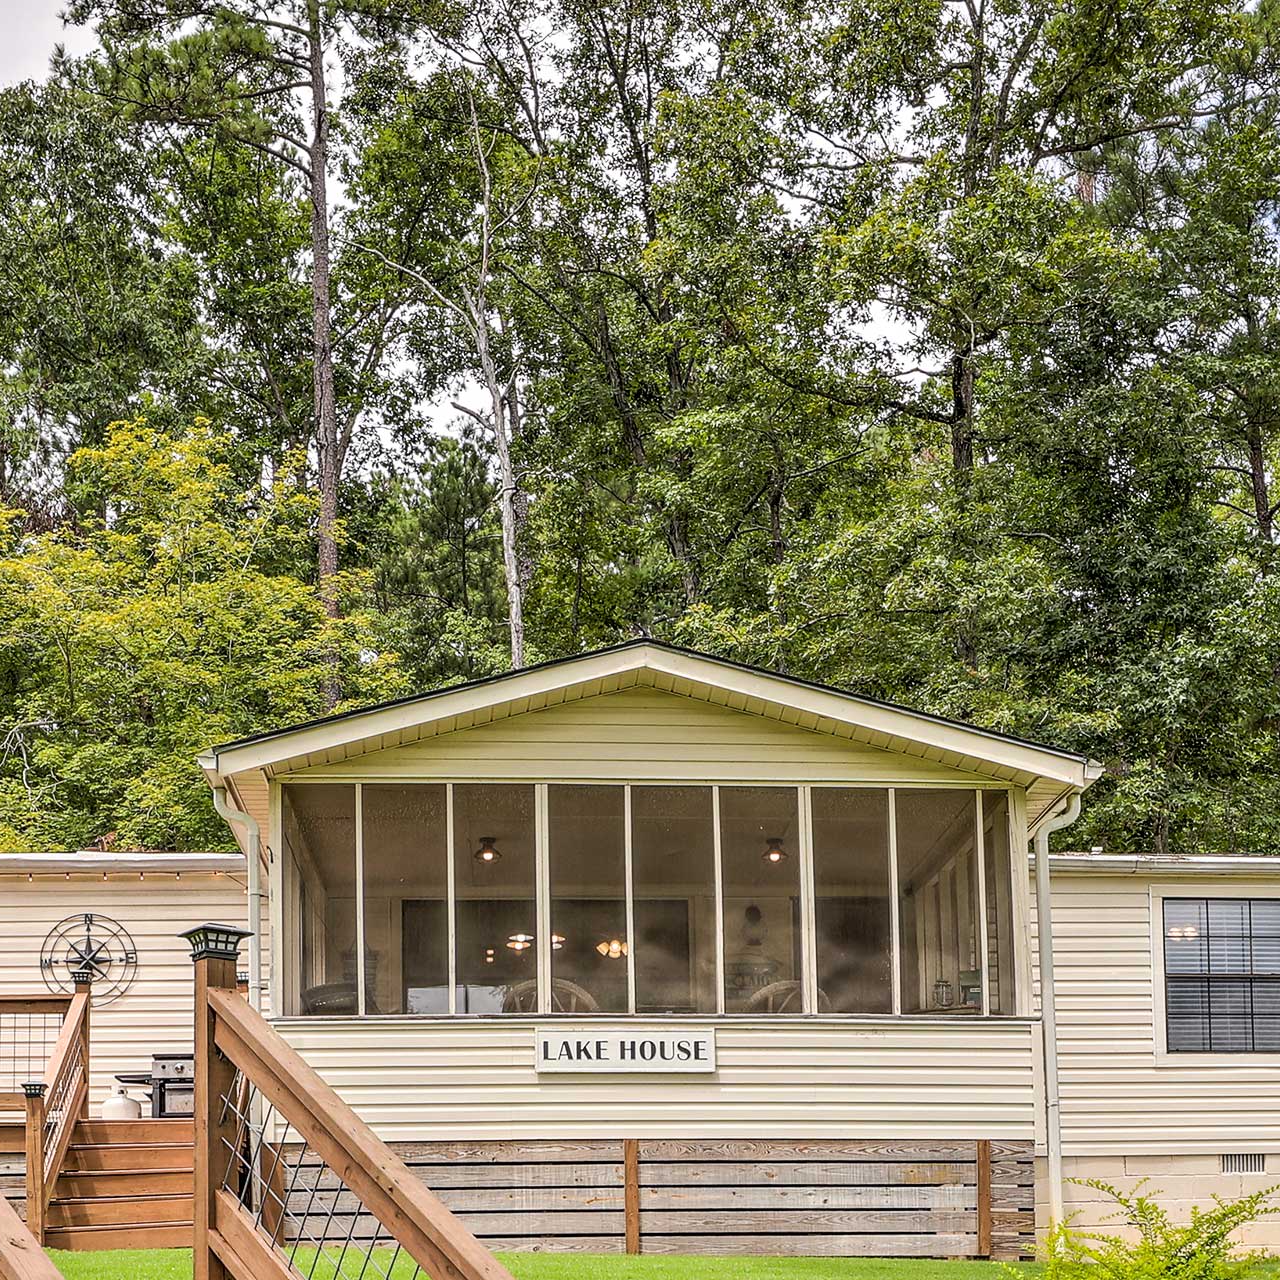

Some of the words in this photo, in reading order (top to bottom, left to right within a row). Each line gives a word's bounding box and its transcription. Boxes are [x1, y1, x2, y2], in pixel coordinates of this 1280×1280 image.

[84, 913, 93, 924] N
[126, 952, 137, 963] E
[41, 958, 51, 969] W
[543, 1040, 610, 1061] LAKE
[619, 1040, 708, 1061] HOUSE
